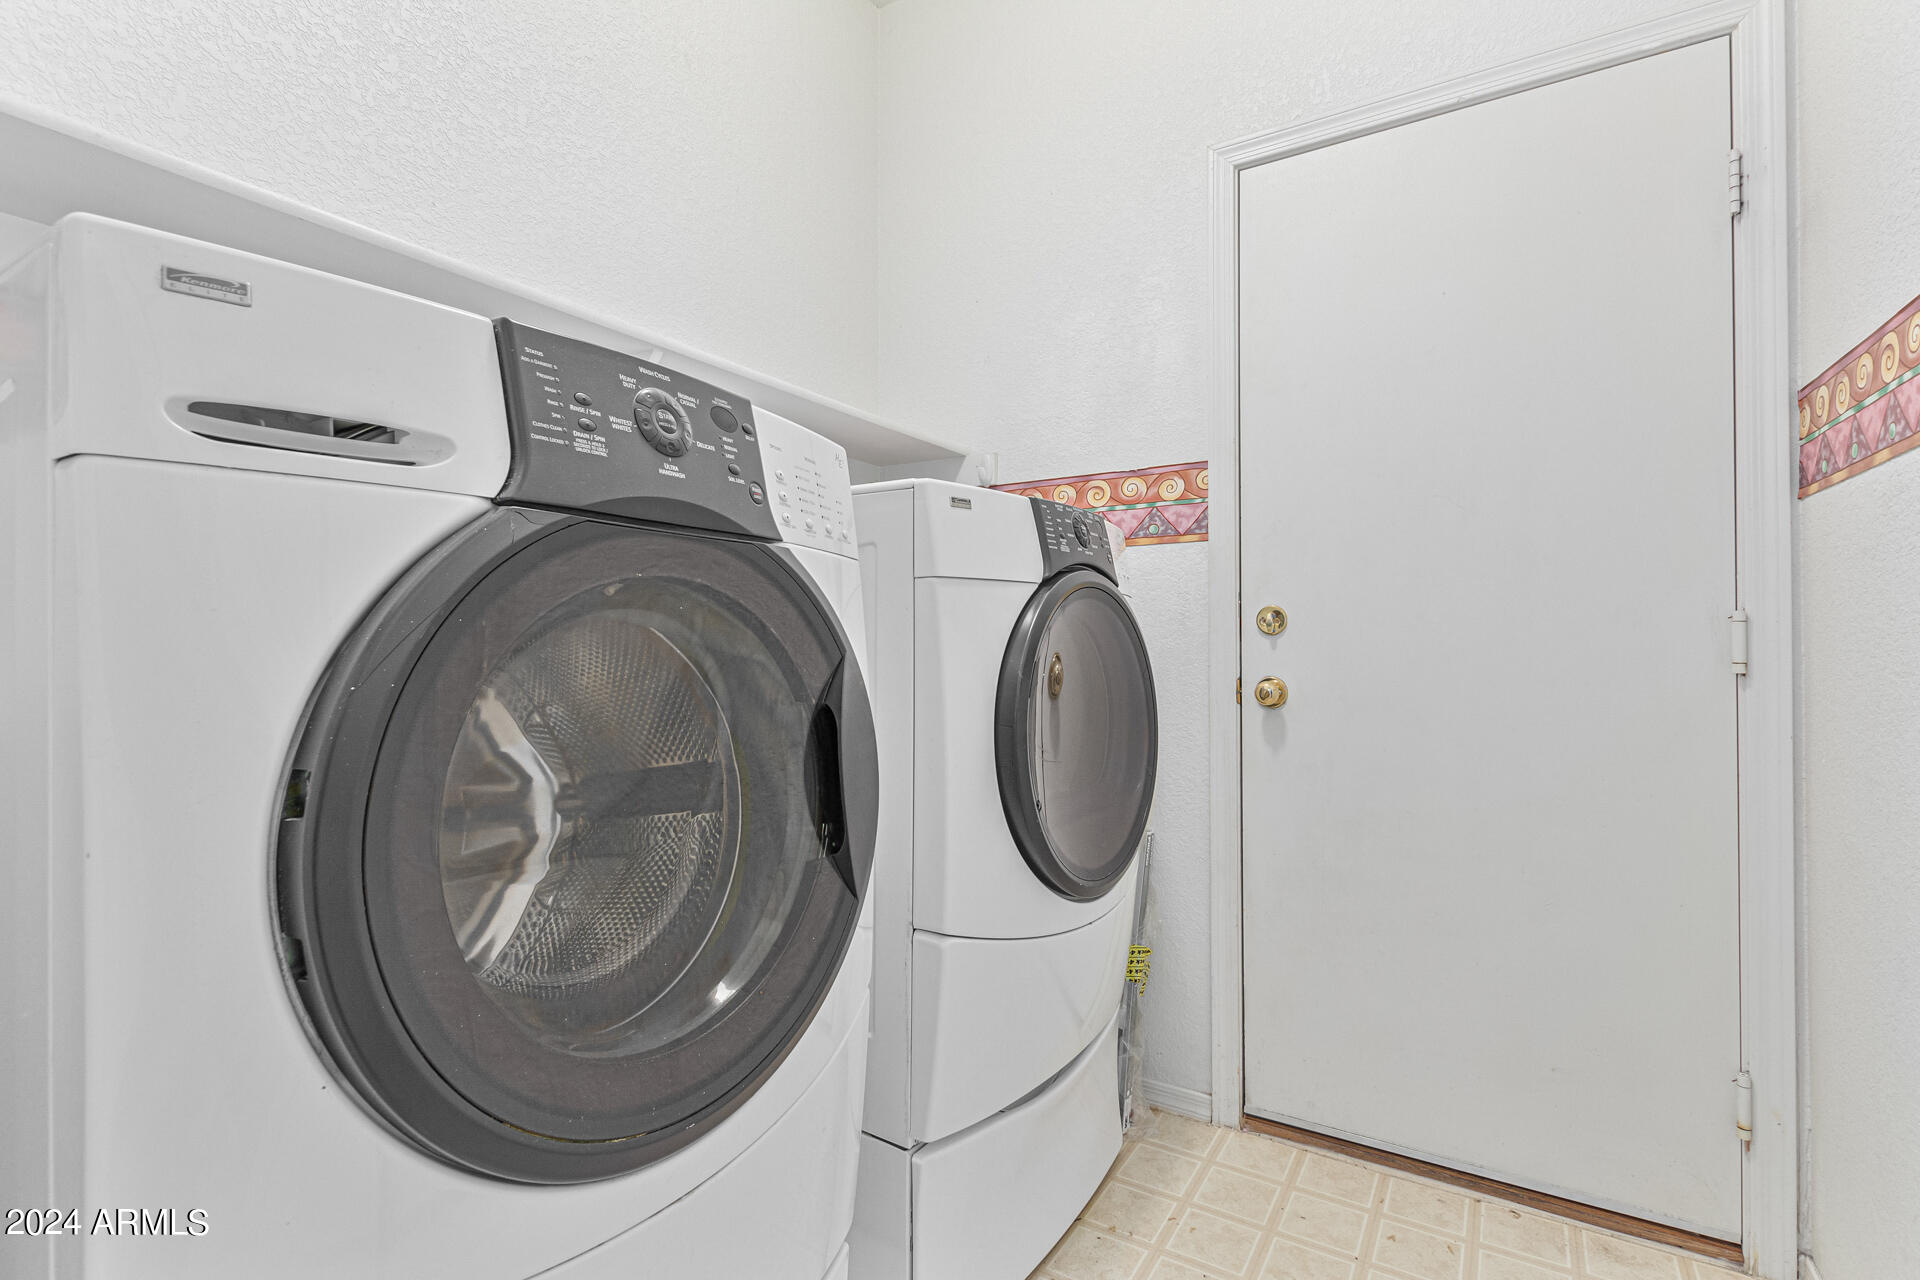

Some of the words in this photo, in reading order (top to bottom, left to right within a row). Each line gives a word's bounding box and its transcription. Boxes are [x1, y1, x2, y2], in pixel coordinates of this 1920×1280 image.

[181, 277, 247, 296] Kenmore
[619, 374, 636, 384] HEAVY
[623, 381, 636, 390] DUTY
[678, 392, 697, 403] NORMAL
[570, 404, 586, 414] RINSE
[588, 409, 601, 417] SPIN
[608, 415, 633, 427] WHITEST
[658, 411, 674, 422] STA
[612, 423, 632, 433] WHITES
[573, 430, 590, 439] DRAIN
[594, 434, 606, 442] SPIN
[664, 463, 679, 472] ULTRA
